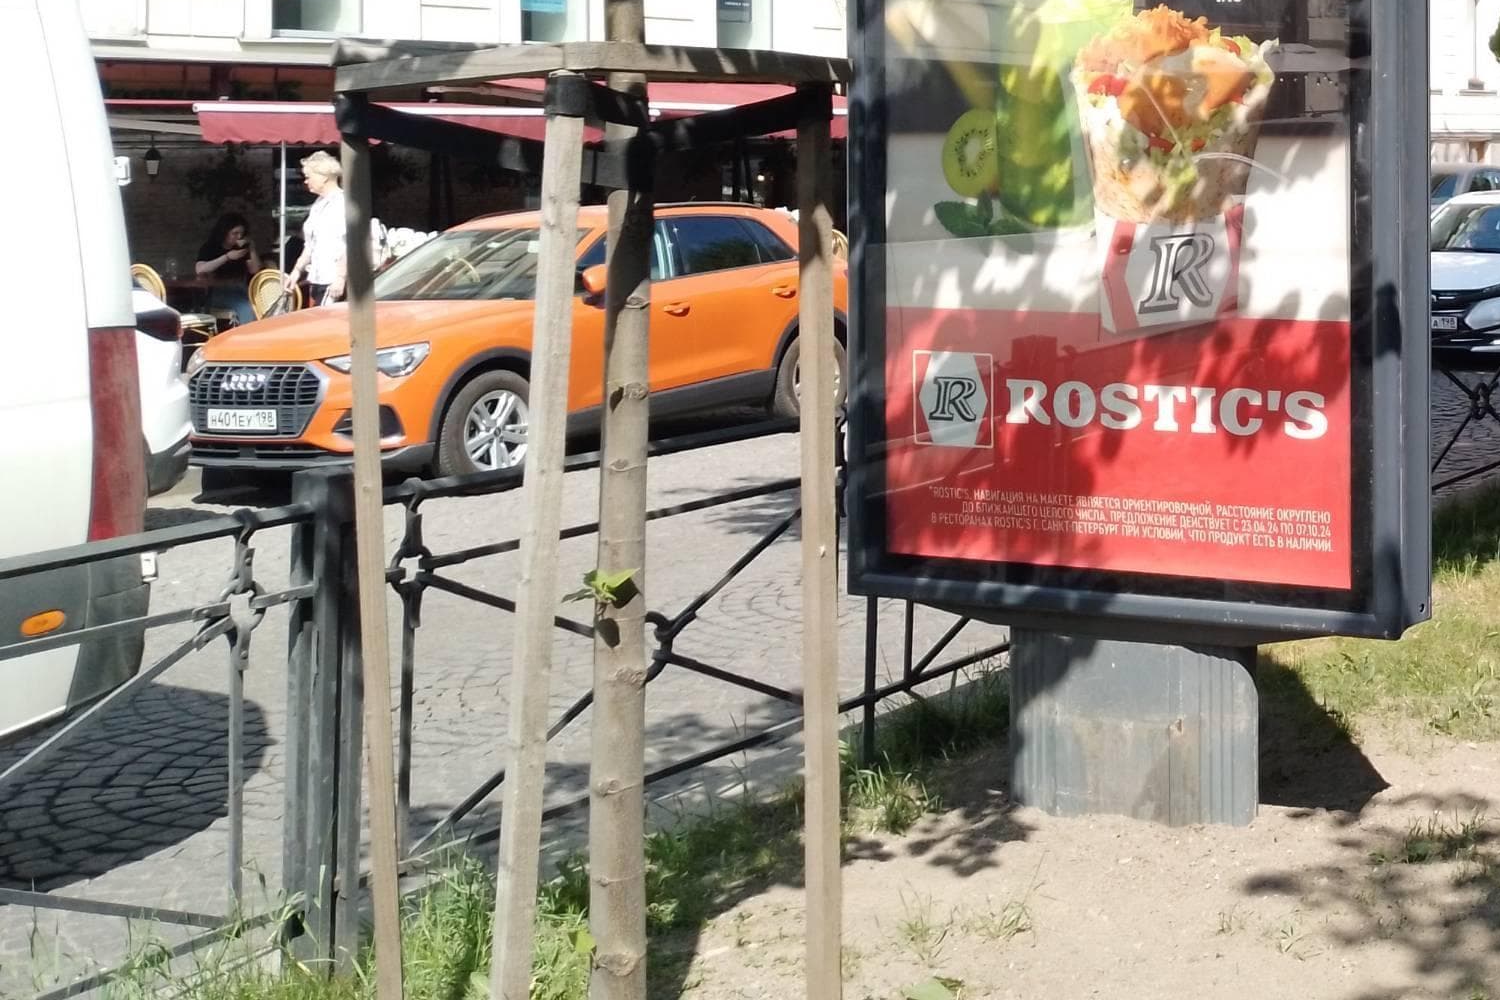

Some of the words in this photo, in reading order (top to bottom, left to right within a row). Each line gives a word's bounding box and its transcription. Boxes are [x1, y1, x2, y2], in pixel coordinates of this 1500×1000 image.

[1006, 378, 1328, 440] ROSTIC'S
[962, 501, 974, 513] ДО
[1040, 506, 1073, 519] ЦЕЛОГО
[1110, 510, 1177, 527] ПРЕДЛОЖЕНИЕ
[1180, 514, 1230, 530] ДЕЙСТВУЕТ
[1233, 520, 1239, 531] С
[1281, 522, 1293, 535] ПО
[974, 488, 1023, 504] НАВИГАЦИЯ
[1026, 492, 1038, 503] НА
[1040, 493, 1073, 506] МАКЕТЕ
[1076, 495, 1121, 510] ЯВЛЯЕТСЯ
[1216, 504, 1274, 520] РАССТОЯНИЕ
[1277, 508, 1331, 524] ОКРУГЛЕНО
[931, 512, 937, 523] В
[939, 512, 992, 527] РЕСТОРАНАХ
[1042, 518, 1120, 536] САНКТ-ПЕТЕРБУРГ
[1122, 524, 1139, 537] ПРИ
[1189, 529, 1206, 542] ЧТО
[1208, 530, 1250, 546] ПРОДУКТ
[1253, 533, 1275, 548] ЕСТЬ
[1277, 536, 1284, 549] В
[1286, 537, 1334, 553] НАЛИЧИИ.
